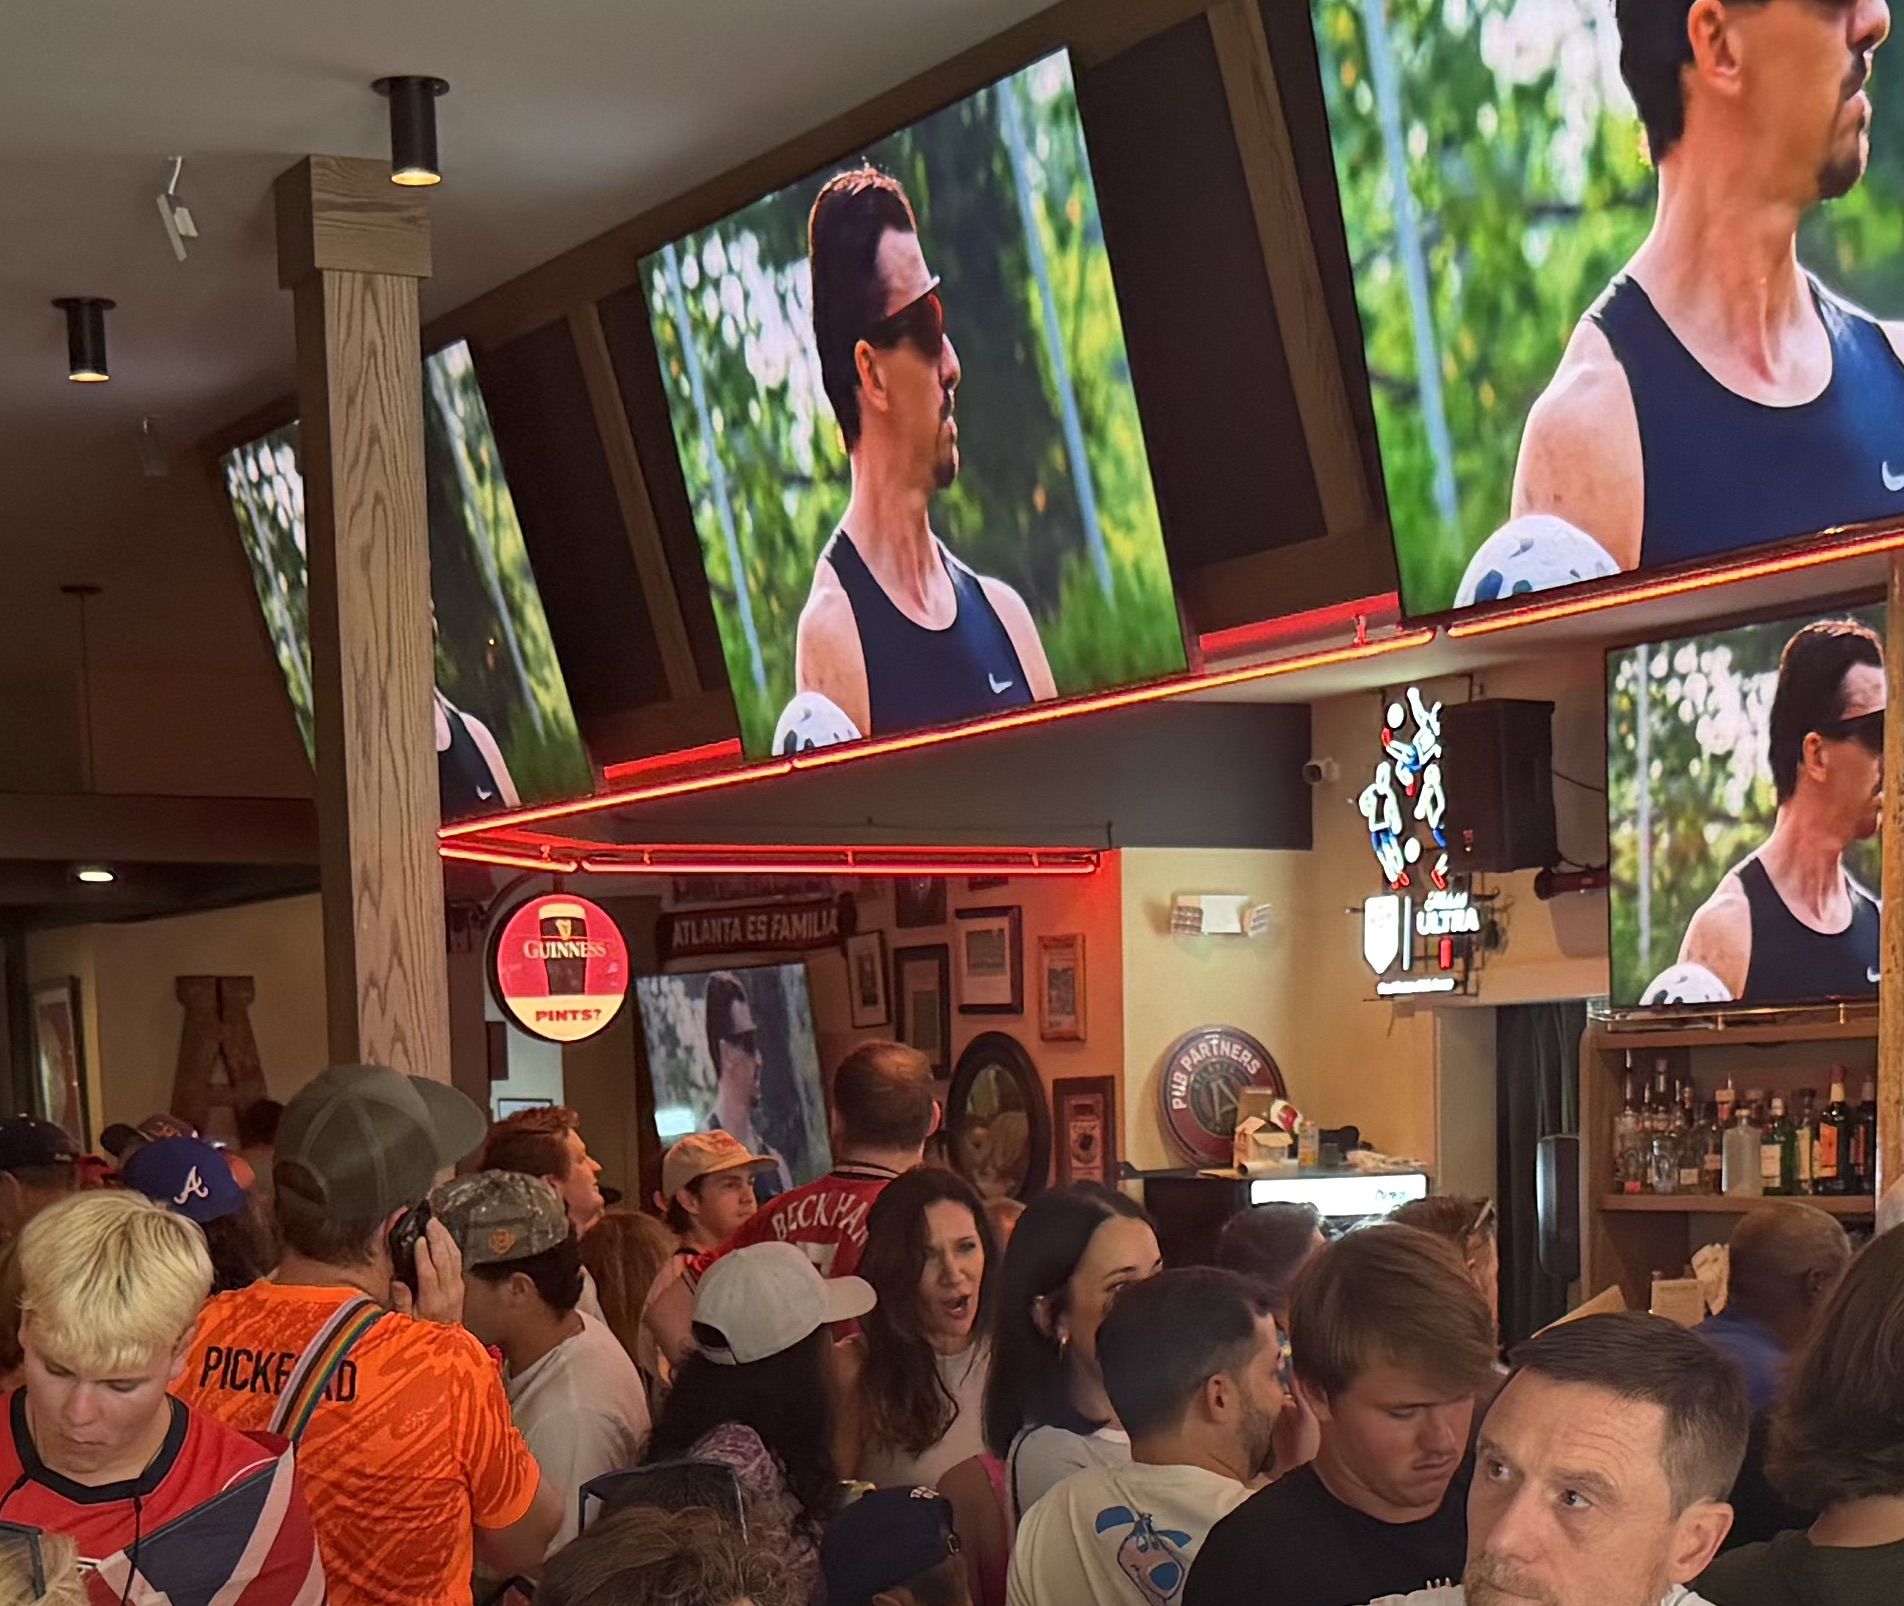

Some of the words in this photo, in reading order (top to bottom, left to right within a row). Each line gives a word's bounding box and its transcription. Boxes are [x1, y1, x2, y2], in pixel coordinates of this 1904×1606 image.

[673, 916, 742, 947] ATLANTA
[747, 914, 768, 941] ES
[770, 908, 838, 939] FAMILIA
[523, 940, 606, 959] GUINNESS
[535, 1009, 602, 1022] PINTS?
[1171, 1071, 1188, 1110] PUB
[1180, 1039, 1261, 1075] PARTNERS
